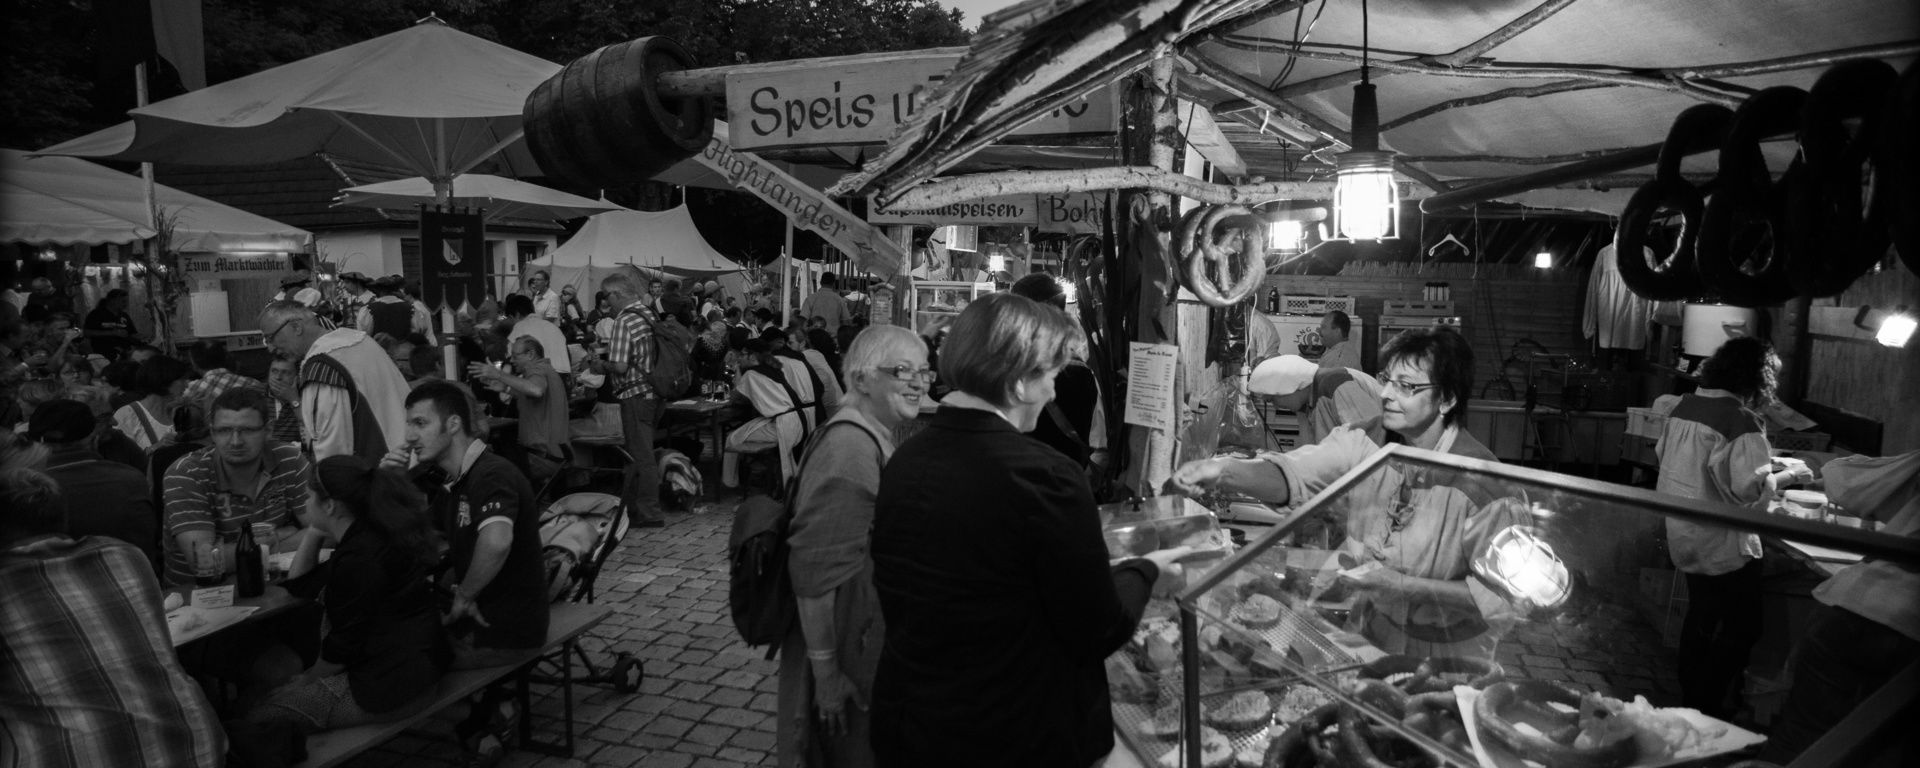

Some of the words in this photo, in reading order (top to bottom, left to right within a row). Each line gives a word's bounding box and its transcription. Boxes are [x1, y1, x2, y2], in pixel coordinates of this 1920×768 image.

[750, 81, 875, 138] Speis
[703, 137, 848, 238] Highlander
[184, 257, 212, 273] Zum
[214, 256, 286, 274] Marktwächter
